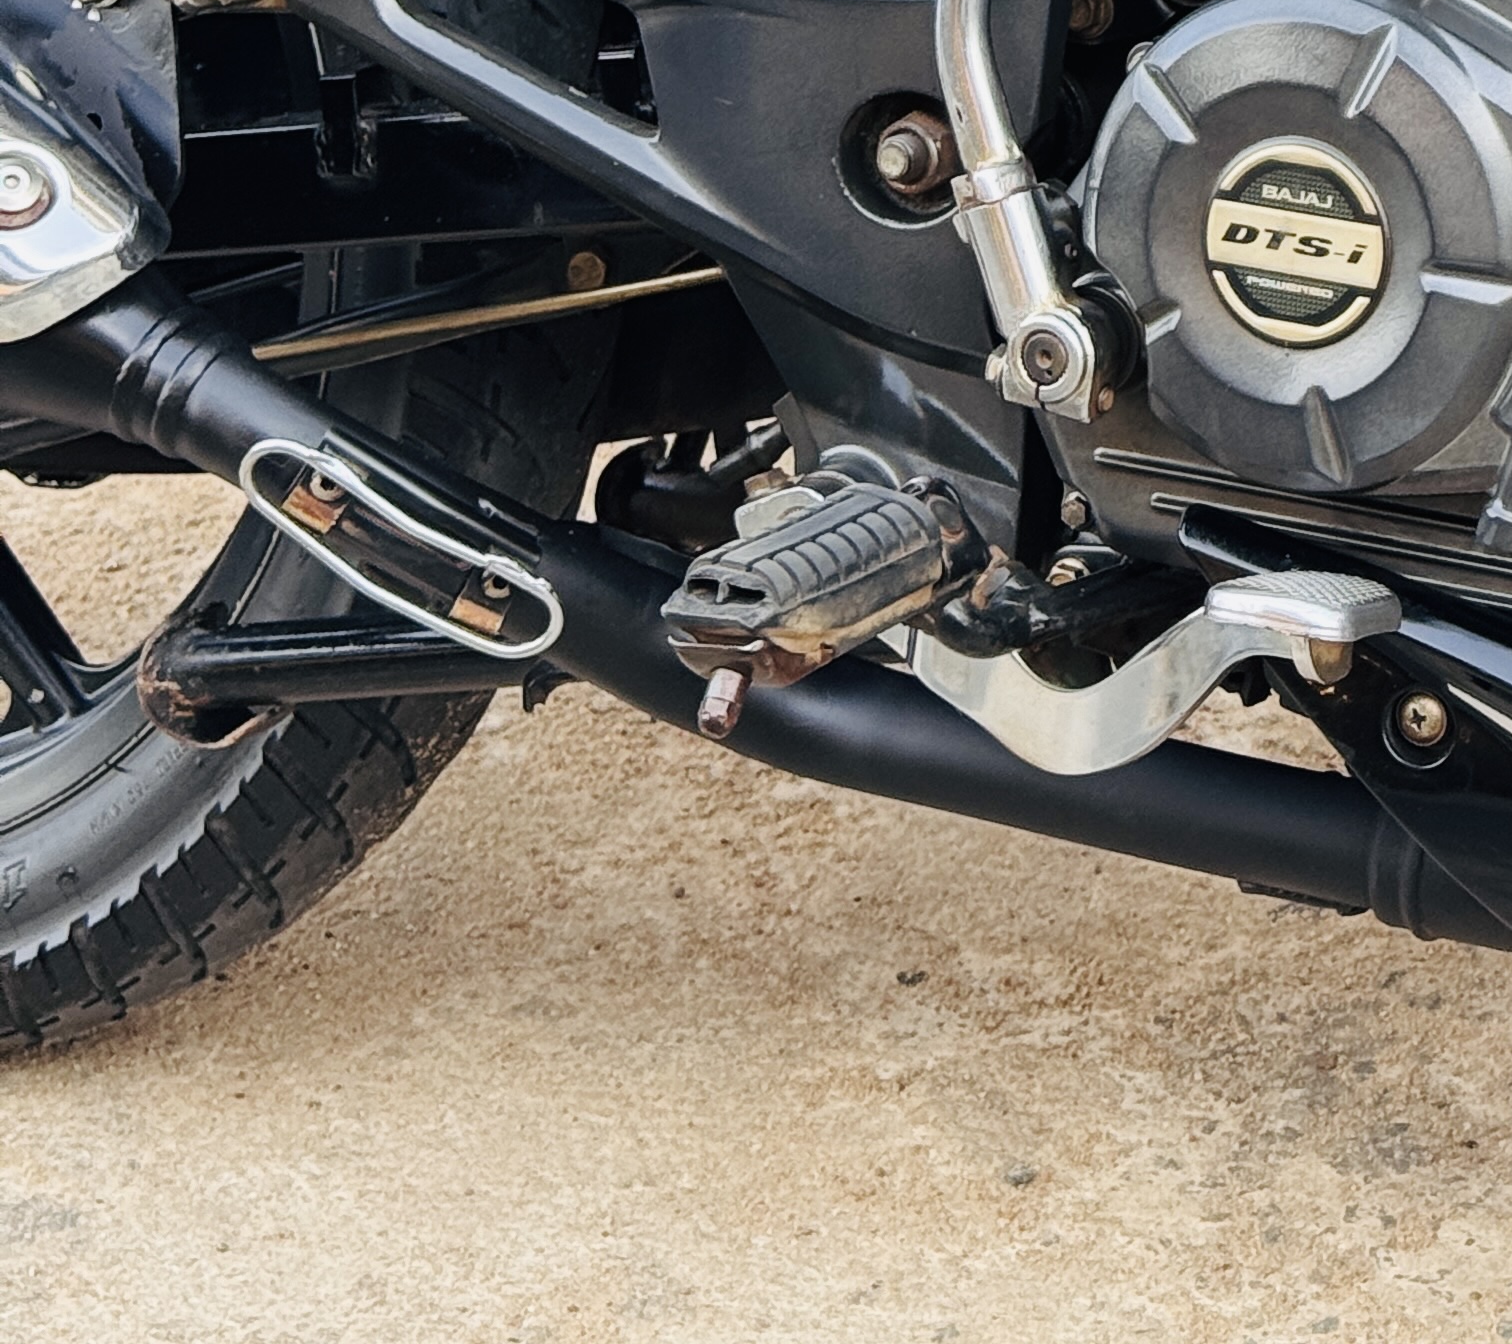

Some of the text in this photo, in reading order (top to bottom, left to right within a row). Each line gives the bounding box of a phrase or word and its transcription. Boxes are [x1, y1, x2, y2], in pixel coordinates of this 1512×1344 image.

[1262, 184, 1334, 208] BAJAJ
[1221, 223, 1369, 264] DTS-i
[1246, 276, 1334, 298] POWERED
